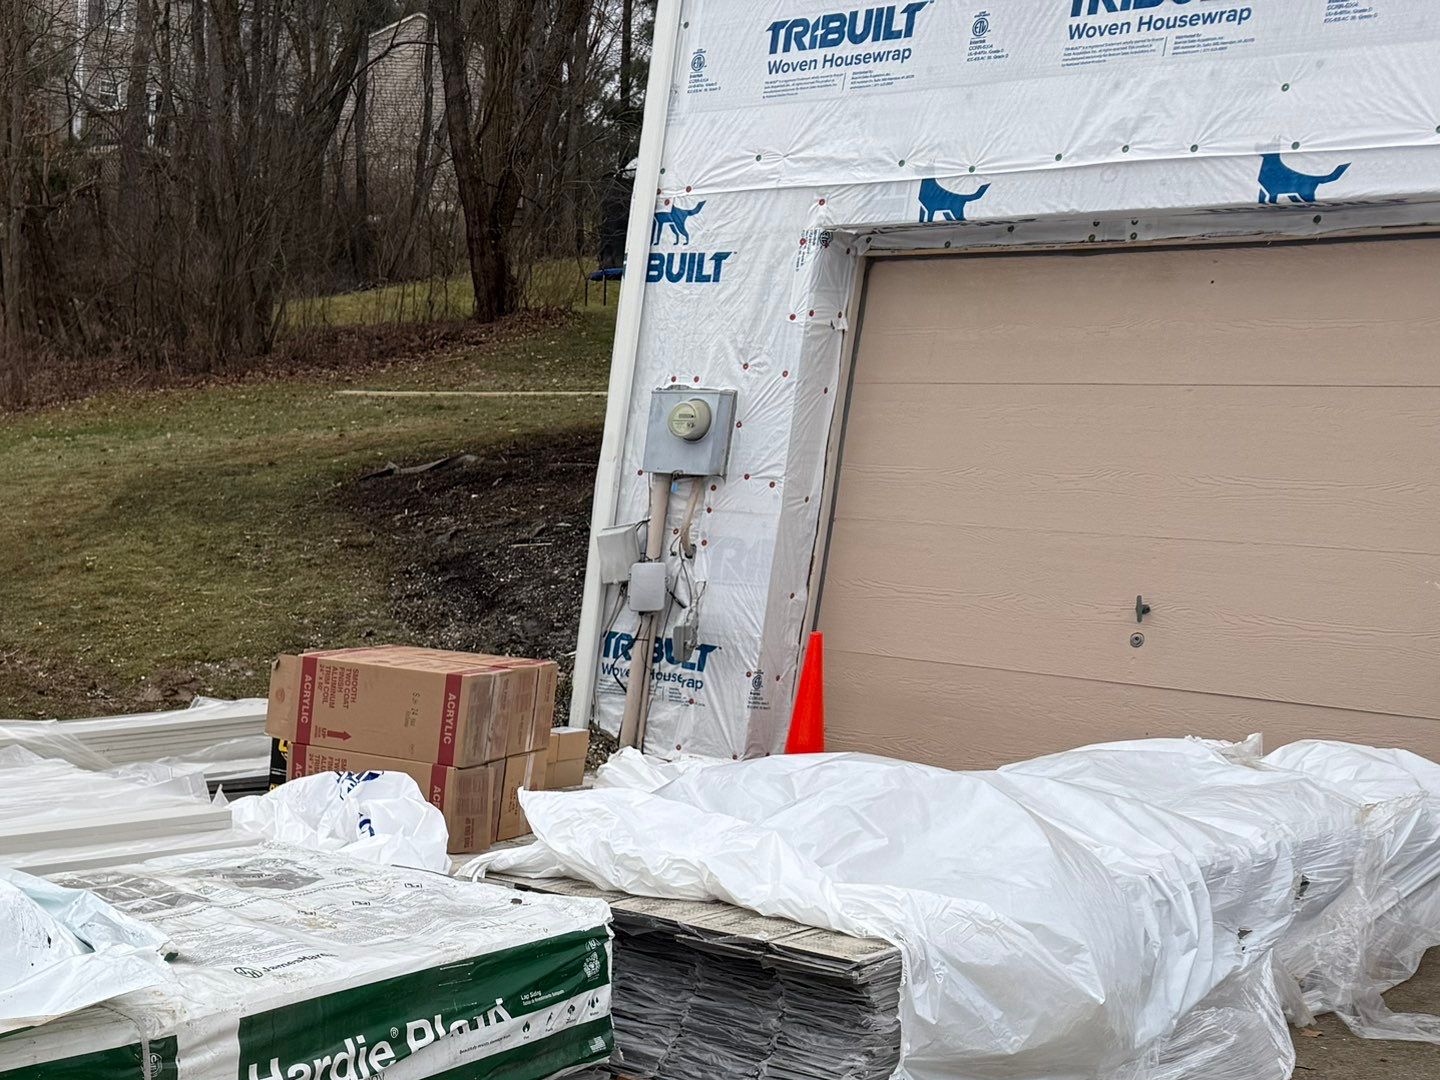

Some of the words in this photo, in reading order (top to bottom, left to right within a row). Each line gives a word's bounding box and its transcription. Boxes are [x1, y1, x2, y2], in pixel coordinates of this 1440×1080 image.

[765, 1, 928, 54] TRIBUILT
[1068, 21, 1131, 40] Woven
[1137, 7, 1252, 32] Housewrap
[768, 56, 817, 75] Woven
[822, 48, 912, 69] Housewrap
[646, 252, 732, 283] BUILT
[324, 665, 332, 685] TRIM
[338, 666, 346, 693] FINISH
[602, 662, 630, 678] Wove
[301, 674, 313, 724] ACRYLIC
[322, 686, 330, 704] COIL
[329, 665, 339, 709] ALUMINUM
[343, 689, 351, 709] COAT
[350, 668, 360, 704] SMOOTH
[443, 692, 457, 745] ACRYLIC
